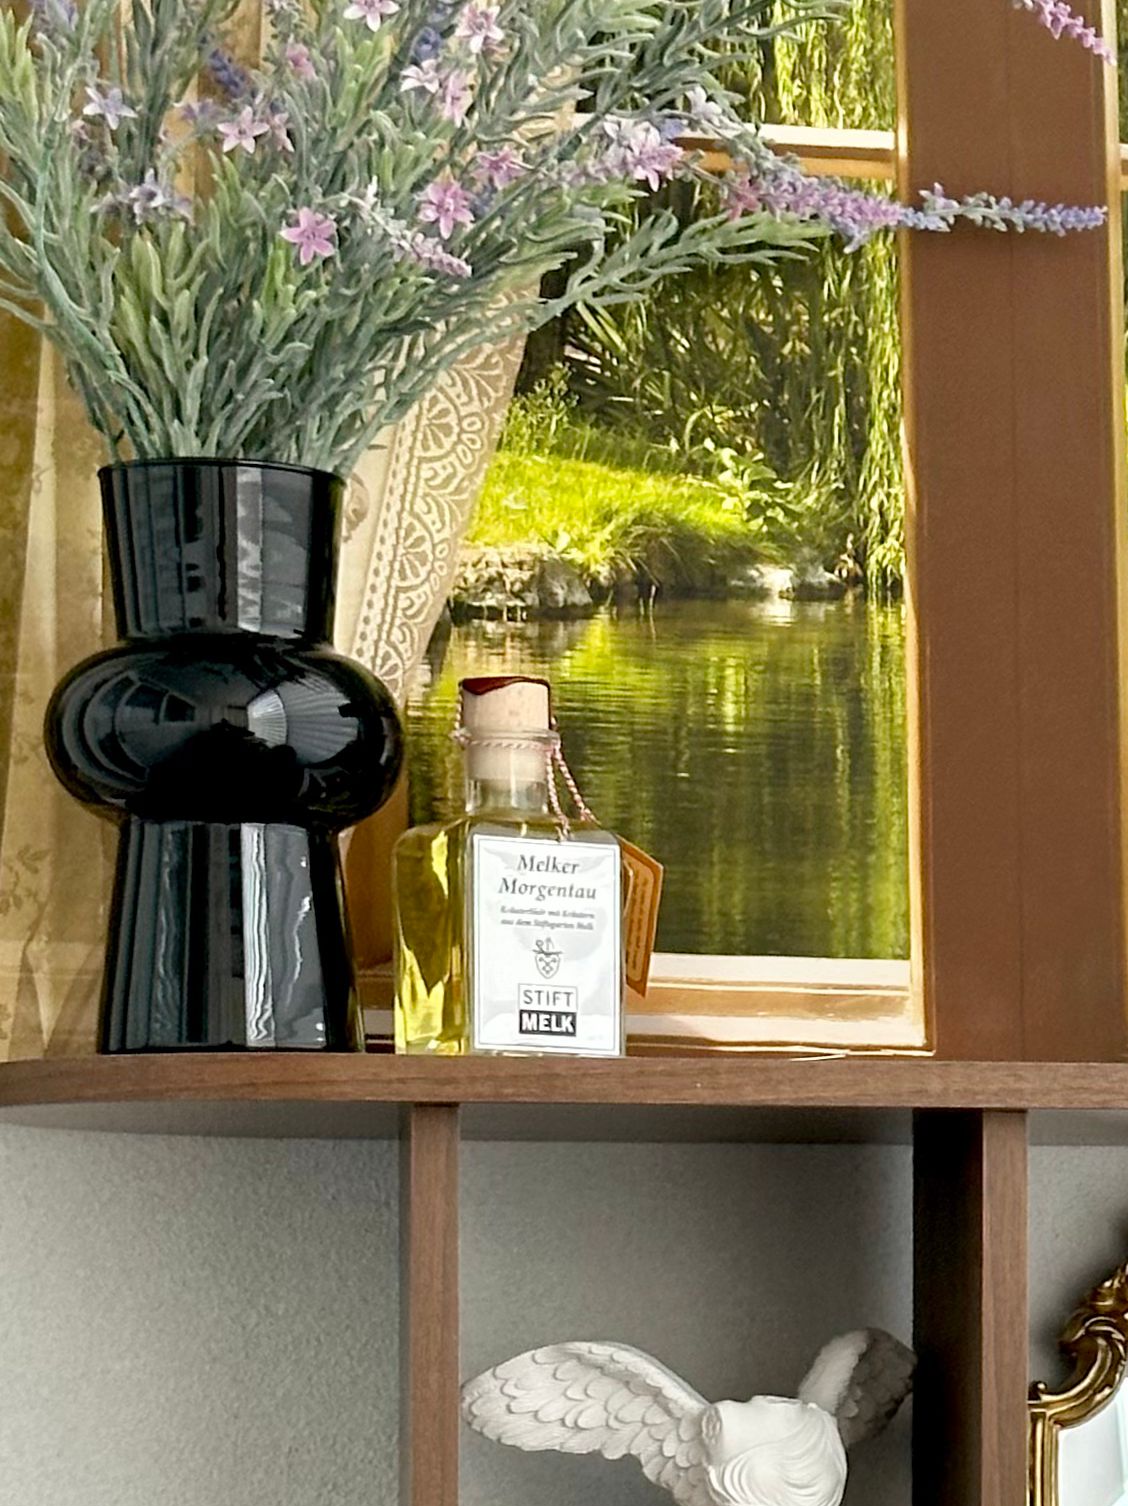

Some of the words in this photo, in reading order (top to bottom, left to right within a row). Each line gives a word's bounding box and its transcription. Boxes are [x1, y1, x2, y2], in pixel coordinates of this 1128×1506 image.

[518, 855, 579, 873] Melker
[499, 878, 596, 901] Morgentau
[524, 990, 573, 1006] STIFT
[522, 1013, 575, 1033] MELK
